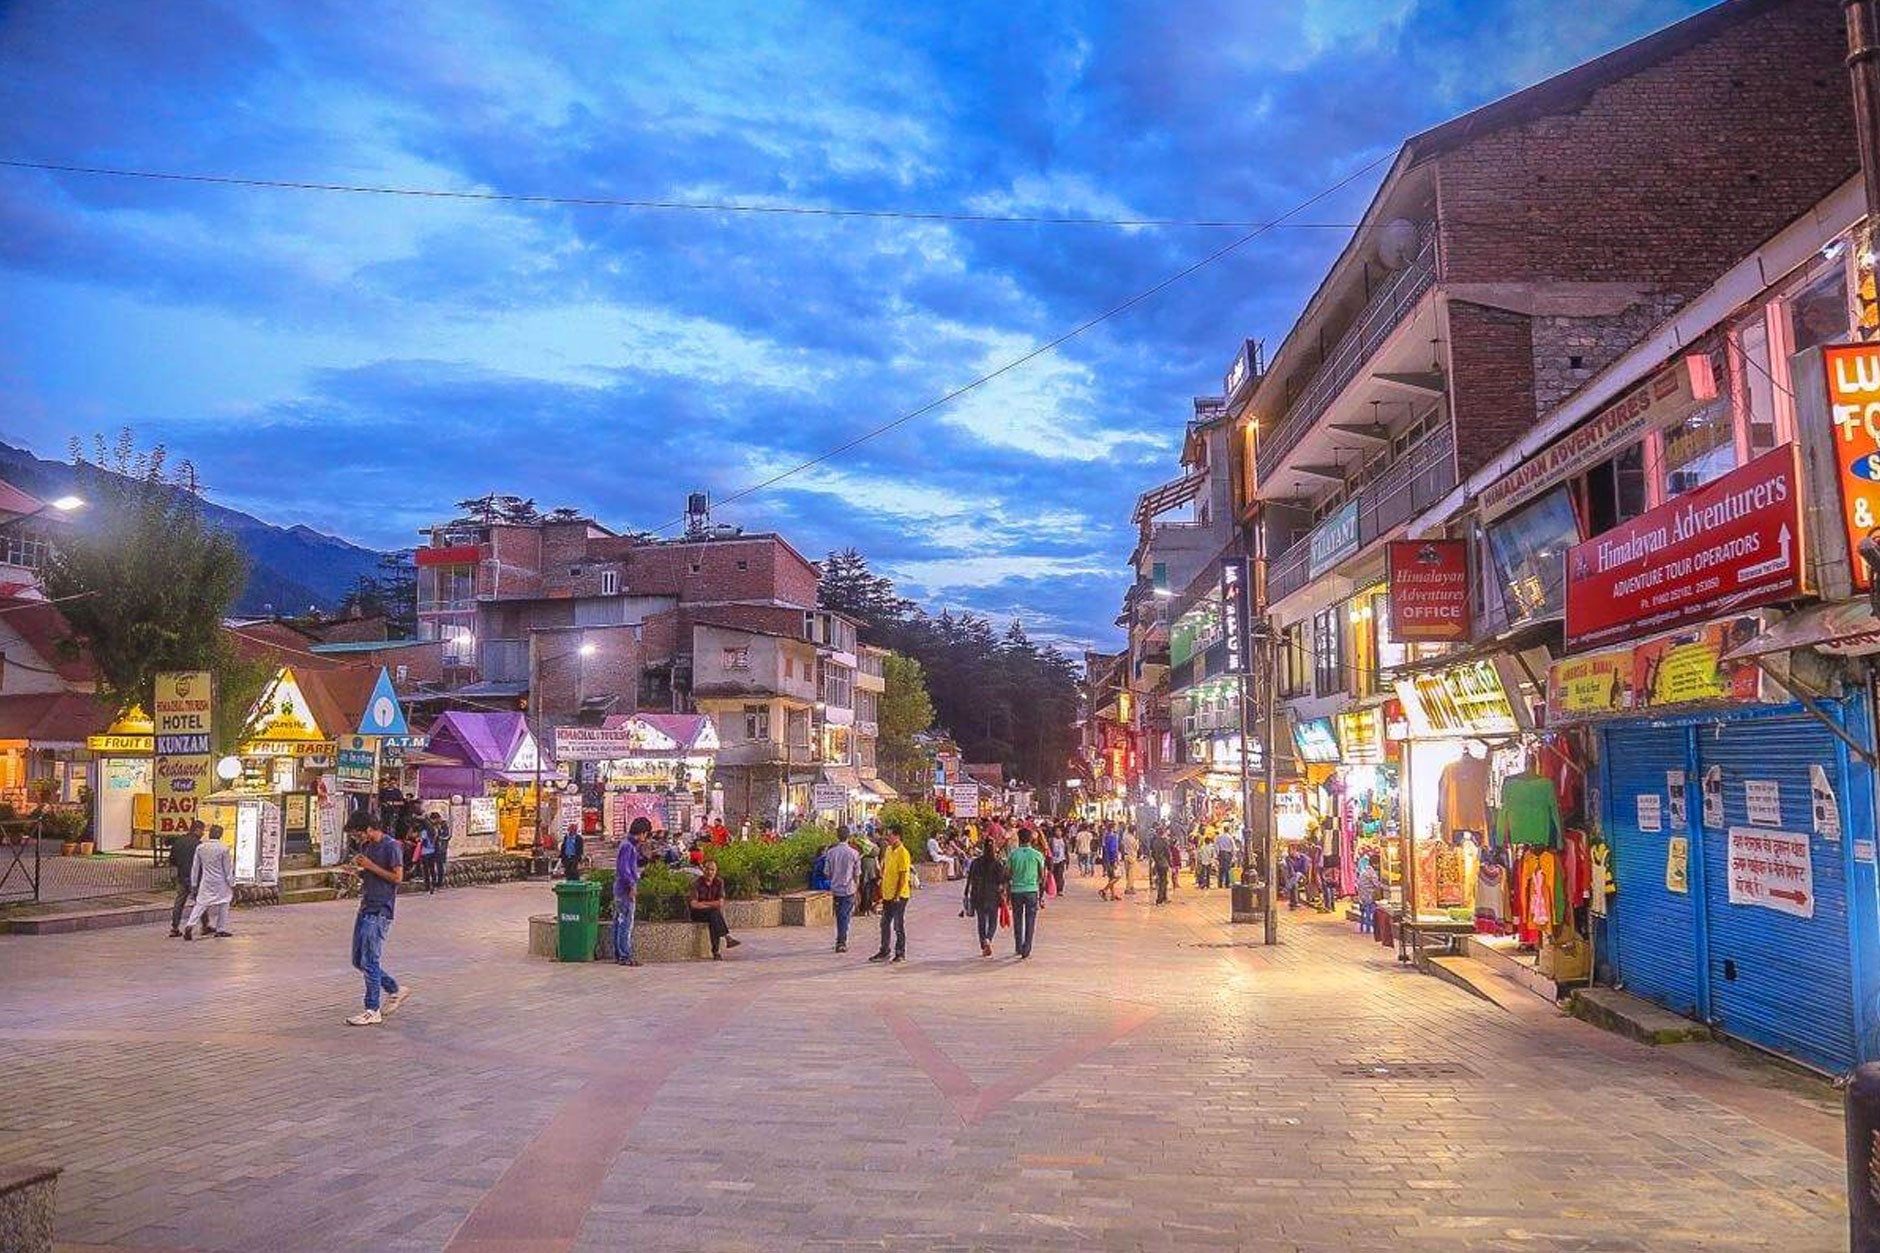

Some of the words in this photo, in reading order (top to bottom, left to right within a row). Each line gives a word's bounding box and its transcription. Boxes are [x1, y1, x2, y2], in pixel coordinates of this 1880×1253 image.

[1484, 454, 1548, 508] HIMALAYAN
[1551, 390, 1650, 468] ADVENTURES
[1597, 527, 1667, 573] Himalayan
[1671, 475, 1787, 545] Adventurers
[1613, 569, 1664, 599] ADVENTURE
[1665, 557, 1692, 581] TOUR
[1694, 532, 1760, 573] OPERATORS
[1397, 569, 1464, 586] Himalayan
[1398, 588, 1464, 602] Adventures
[1403, 606, 1460, 618] OFFICE
[162, 715, 202, 729] HOTEL
[105, 738, 142, 748] FRUIT
[158, 736, 208, 753] KUNZAM
[252, 742, 295, 753] FRUIT
[385, 737, 429, 748] A.T.M.
